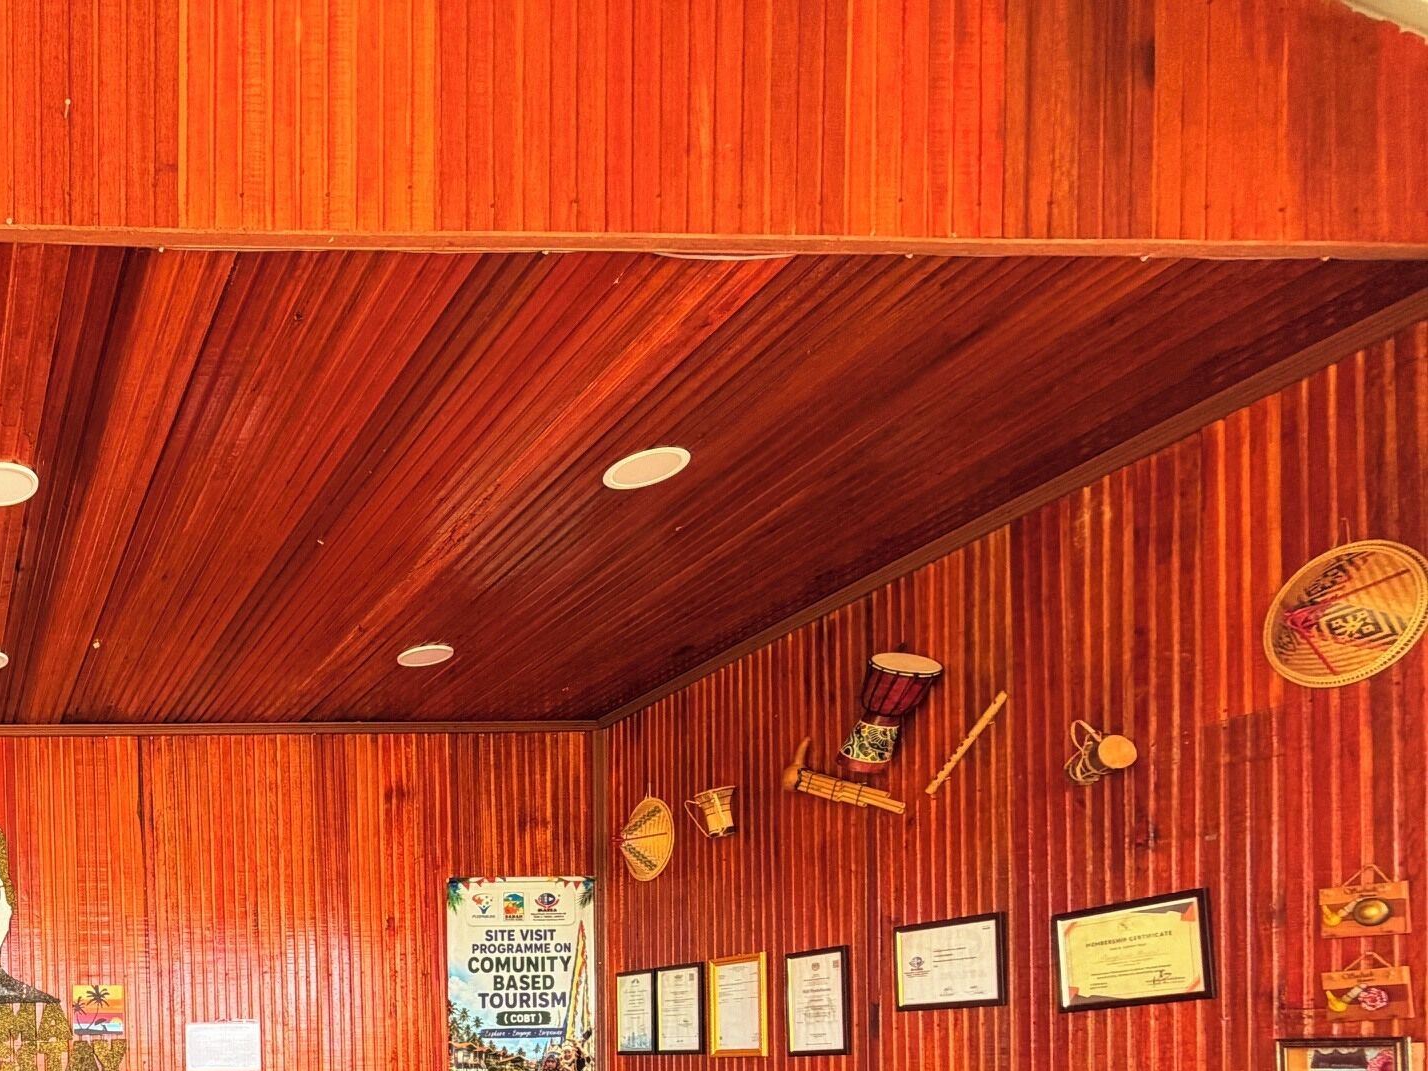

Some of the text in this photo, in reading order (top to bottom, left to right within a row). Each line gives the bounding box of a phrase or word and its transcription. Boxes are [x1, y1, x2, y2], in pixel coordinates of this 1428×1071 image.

[485, 929, 556, 941] SITE VISIT
[472, 943, 571, 954] PROGRAMME ON
[468, 956, 571, 973] COMUNITY
[493, 975, 555, 990] BASED
[478, 992, 566, 1008] TOURISM
